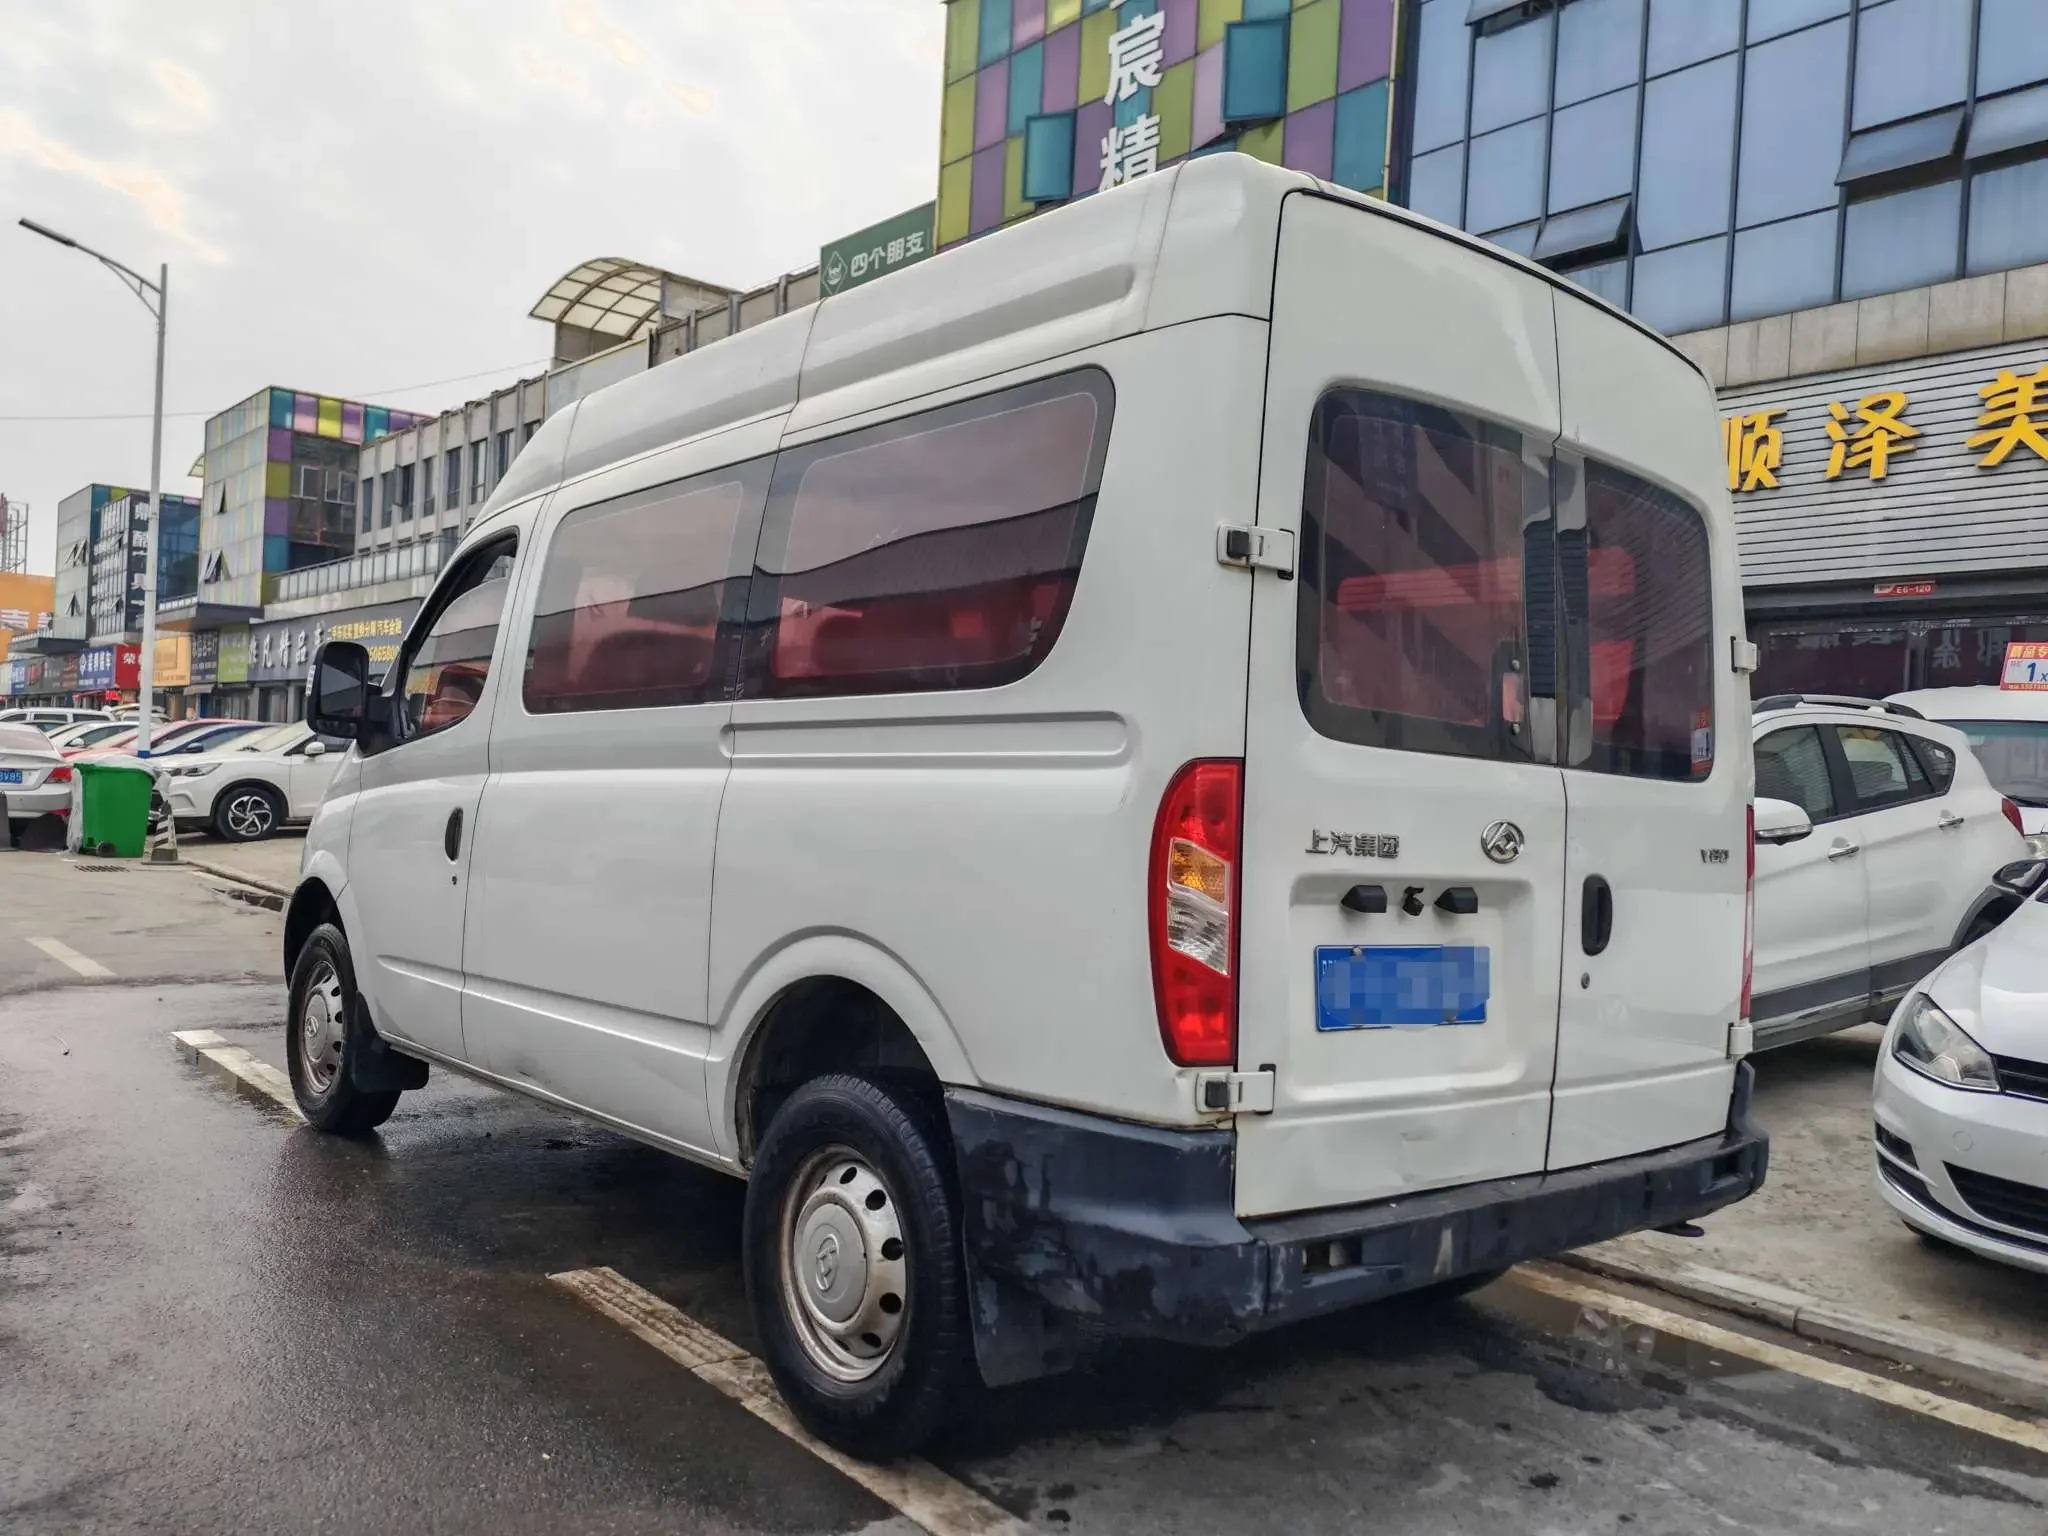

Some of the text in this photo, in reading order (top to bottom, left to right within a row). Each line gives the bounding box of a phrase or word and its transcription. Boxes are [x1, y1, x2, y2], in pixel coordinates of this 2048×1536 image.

[1099, 0, 1165, 191] 宸精
[1305, 828, 1400, 858] 上汽集团
